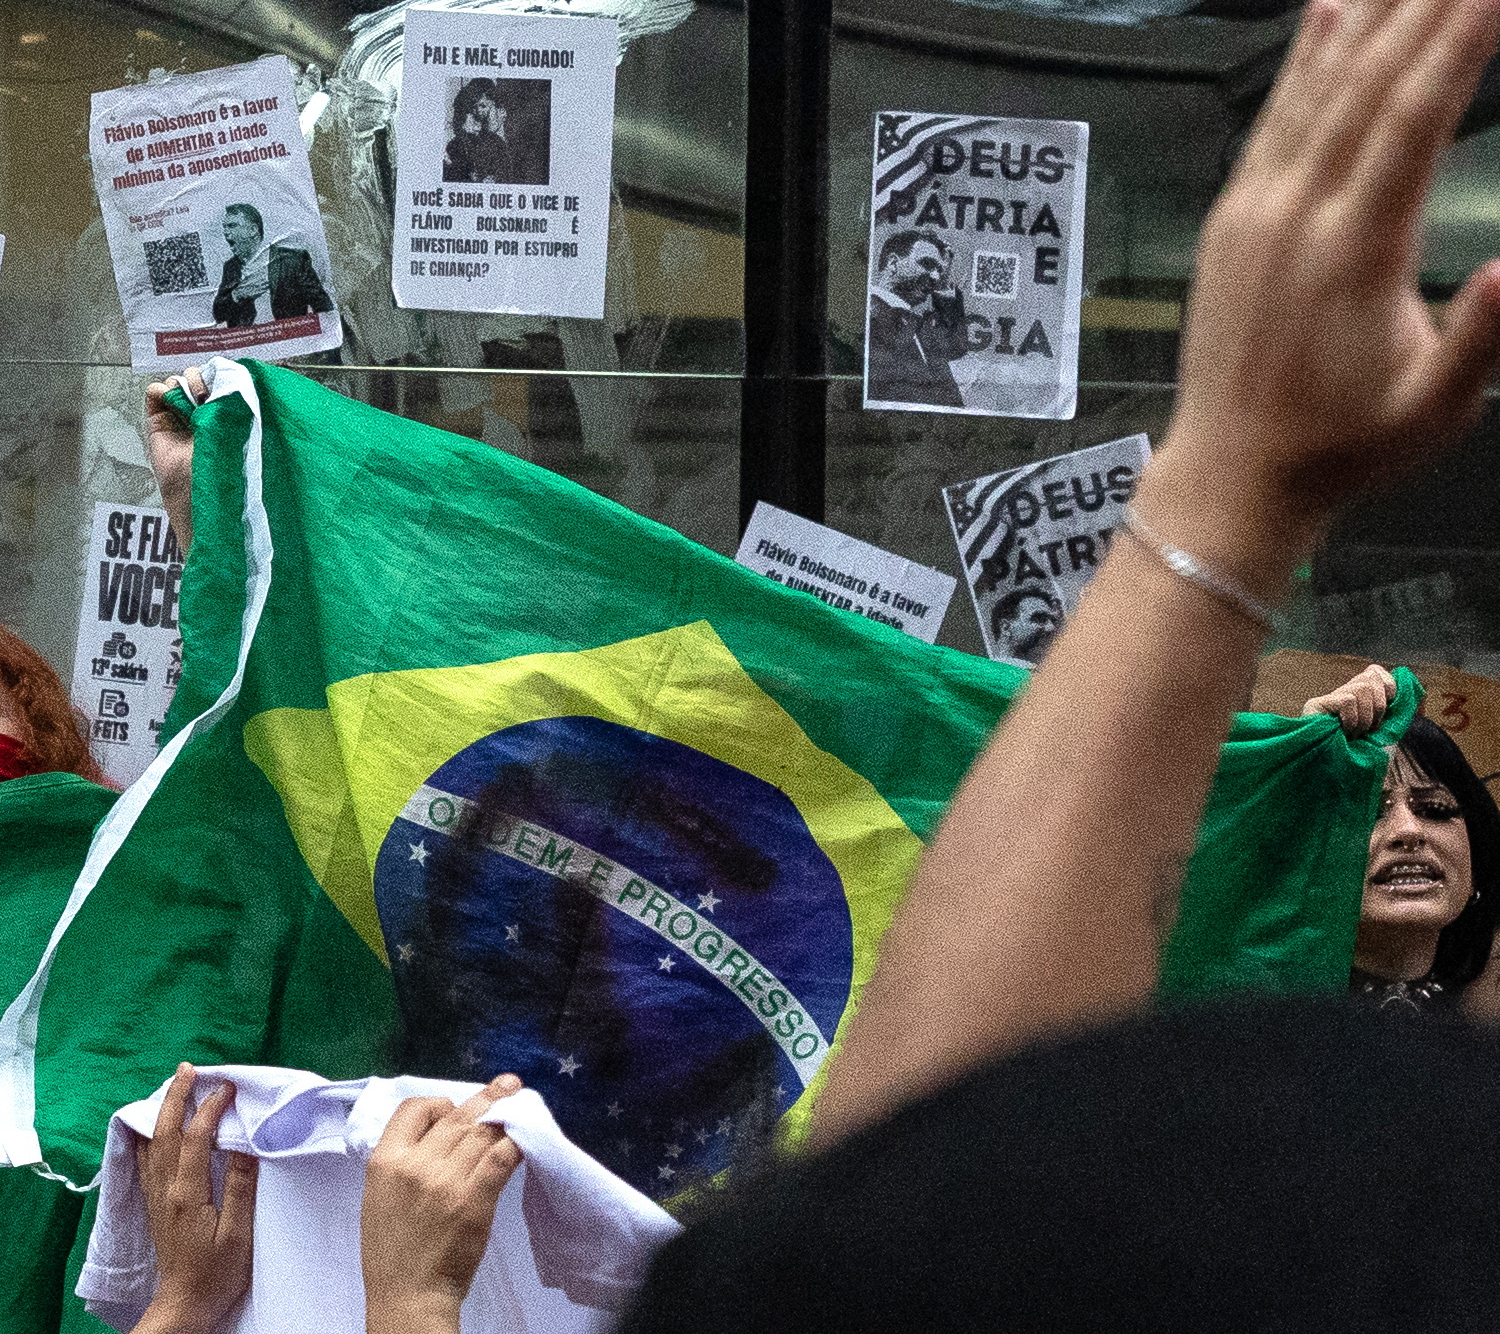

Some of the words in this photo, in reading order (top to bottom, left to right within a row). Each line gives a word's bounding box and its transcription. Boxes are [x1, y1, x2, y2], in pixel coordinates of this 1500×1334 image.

[423, 43, 447, 65] PAI
[451, 47, 460, 65] E
[465, 44, 502, 68] MÃE,
[507, 48, 574, 68] CUIDADO!
[104, 122, 145, 144] Flávio
[148, 110, 216, 135] Bolsonaro
[220, 104, 229, 120] é
[232, 106, 241, 117] a
[243, 96, 279, 116] favor
[126, 147, 144, 164] de
[147, 132, 215, 160] AUMENTAR
[218, 134, 226, 145] a
[230, 122, 267, 142] idade
[933, 136, 1065, 184] DEUS
[113, 169, 164, 190] mínima
[168, 163, 185, 179] da
[188, 141, 291, 176] aposentadoria.
[412, 188, 443, 207] VOCÊ
[449, 192, 484, 208] SABIA
[490, 193, 512, 209] QUE
[518, 194, 527, 209] O
[532, 195, 558, 211] VICE
[564, 196, 579, 211] DE
[411, 211, 453, 230] FLÁVIO
[476, 216, 547, 233] BOLSONARO
[572, 216, 579, 234] É
[410, 237, 488, 255] INVESTIGADO
[495, 241, 518, 255] POR
[525, 241, 578, 258] ESTUPRO
[1033, 246, 1060, 285] E
[410, 261, 426, 276] DE
[430, 261, 490, 281] CRIANÇA?
[1008, 465, 1136, 528] DEUS
[105, 511, 137, 560] SE
[756, 538, 797, 567] Flávio
[800, 555, 867, 595] Bolsonaro
[869, 583, 881, 599] é
[880, 590, 890, 604] a
[893, 592, 930, 619] favor
[93, 719, 129, 742] FGTS
[617, 877, 820, 1061] PROGRESSO
